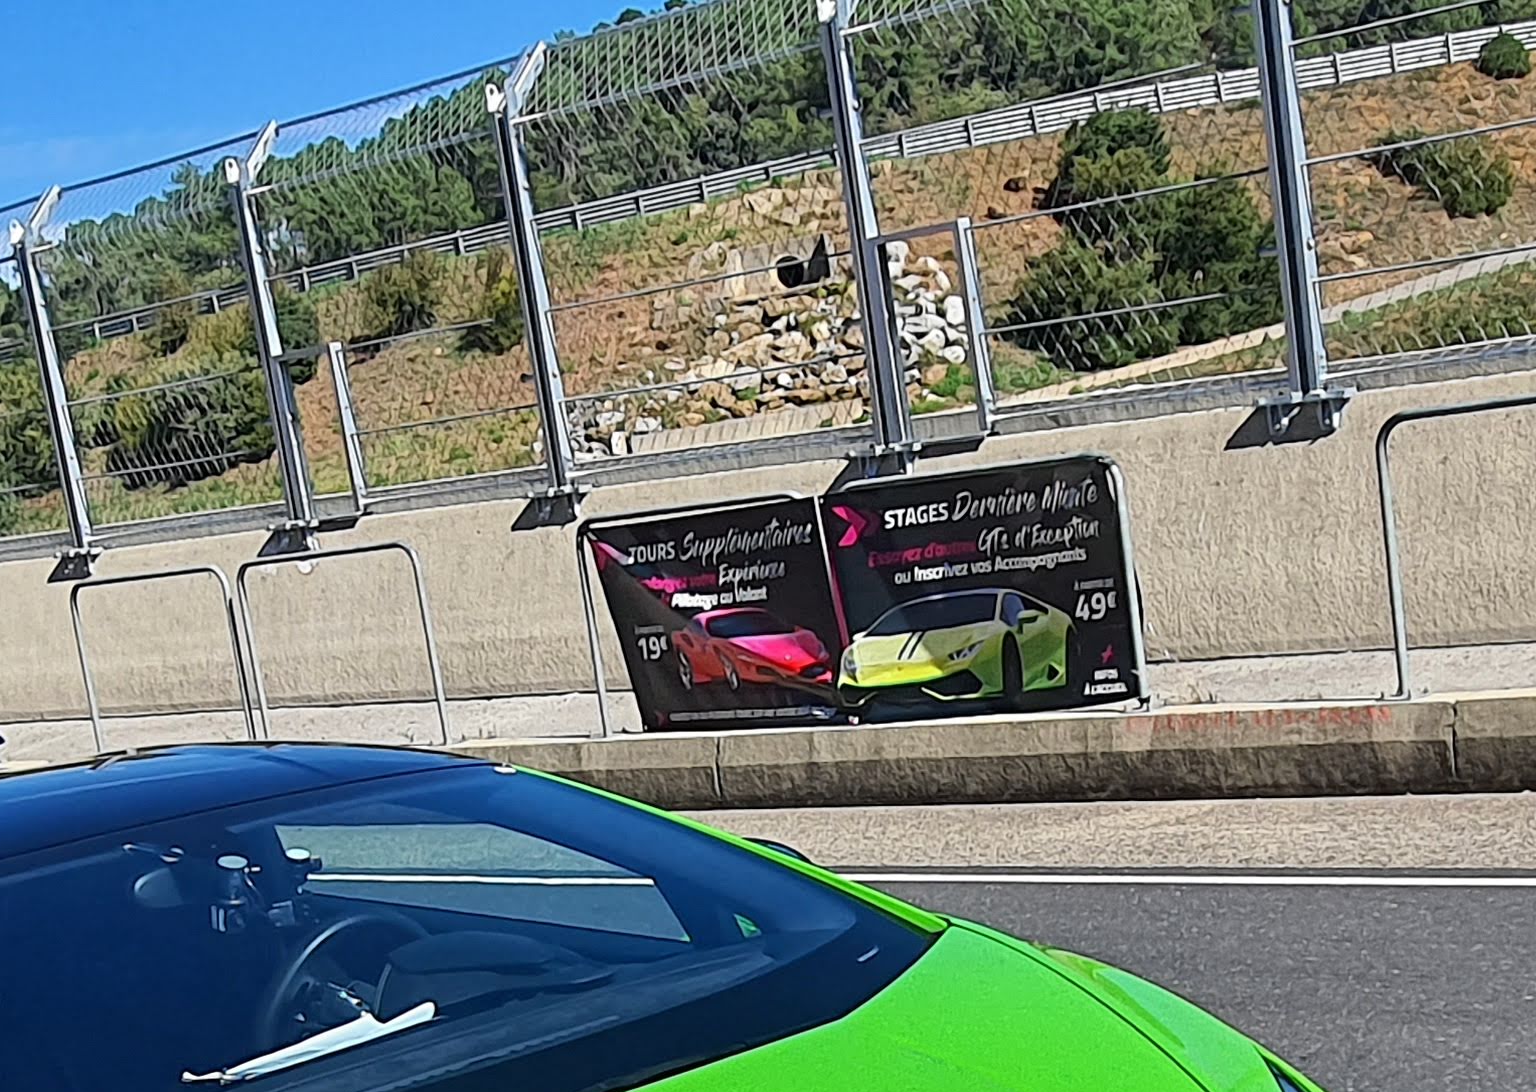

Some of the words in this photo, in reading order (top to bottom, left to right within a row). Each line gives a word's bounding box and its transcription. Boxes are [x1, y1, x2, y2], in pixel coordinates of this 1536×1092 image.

[884, 501, 949, 529] STAGES
[951, 488, 1037, 521] Dernière
[629, 541, 676, 564] TOURS
[678, 517, 814, 566] Supplémentaires
[894, 570, 911, 585] ou
[914, 560, 968, 582] Inscrivez
[971, 558, 992, 574] vos
[1075, 591, 1117, 621] 49€
